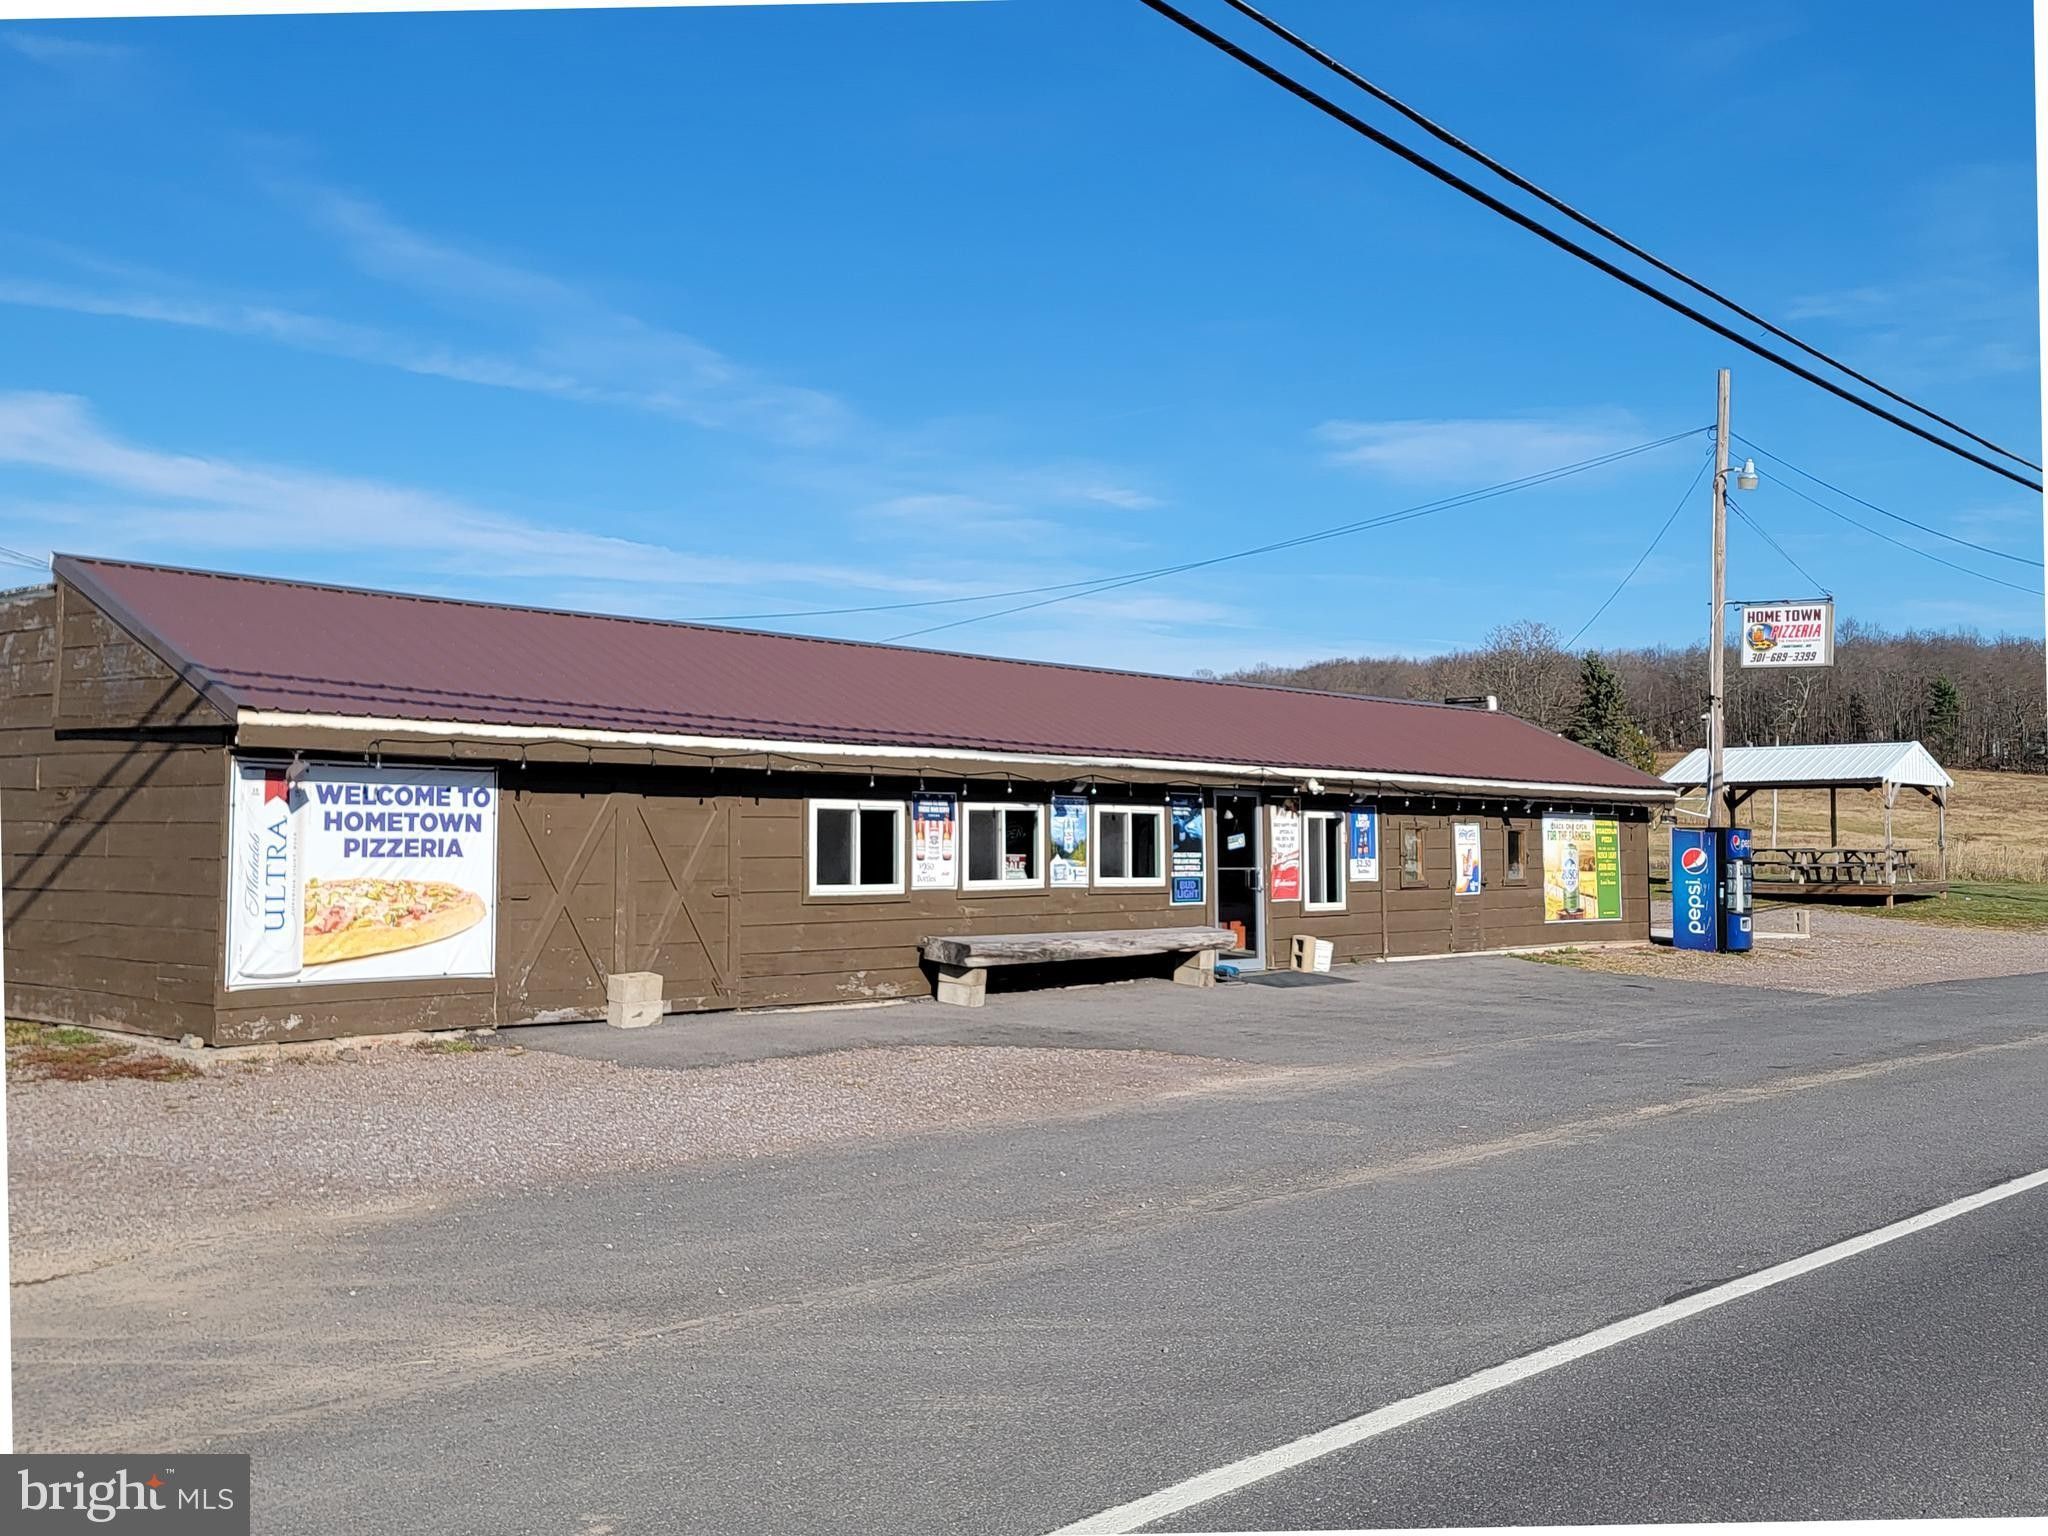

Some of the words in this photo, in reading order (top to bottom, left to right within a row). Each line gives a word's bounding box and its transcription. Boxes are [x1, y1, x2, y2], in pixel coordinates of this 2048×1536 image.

[1747, 610, 1782, 623] HOME
[1785, 608, 1822, 622] TOWN
[1771, 624, 1822, 639] PIZZERIA
[1750, 651, 1817, 663] 301-689-3399
[315, 783, 451, 807] WELCOME
[458, 785, 491, 808] TO
[323, 811, 483, 833] HOMETOWN
[1547, 830, 1557, 840] FOR
[1558, 830, 1568, 840] THE
[343, 837, 464, 859] PIZZERIA
[1005, 861, 1026, 870] SALE
[245, 830, 261, 918] Michelob
[264, 816, 289, 933] ULTRA
[1179, 880, 1197, 890] BUD
[1176, 889, 1199, 899] LIGHT
[1686, 878, 1705, 935] pepsi
